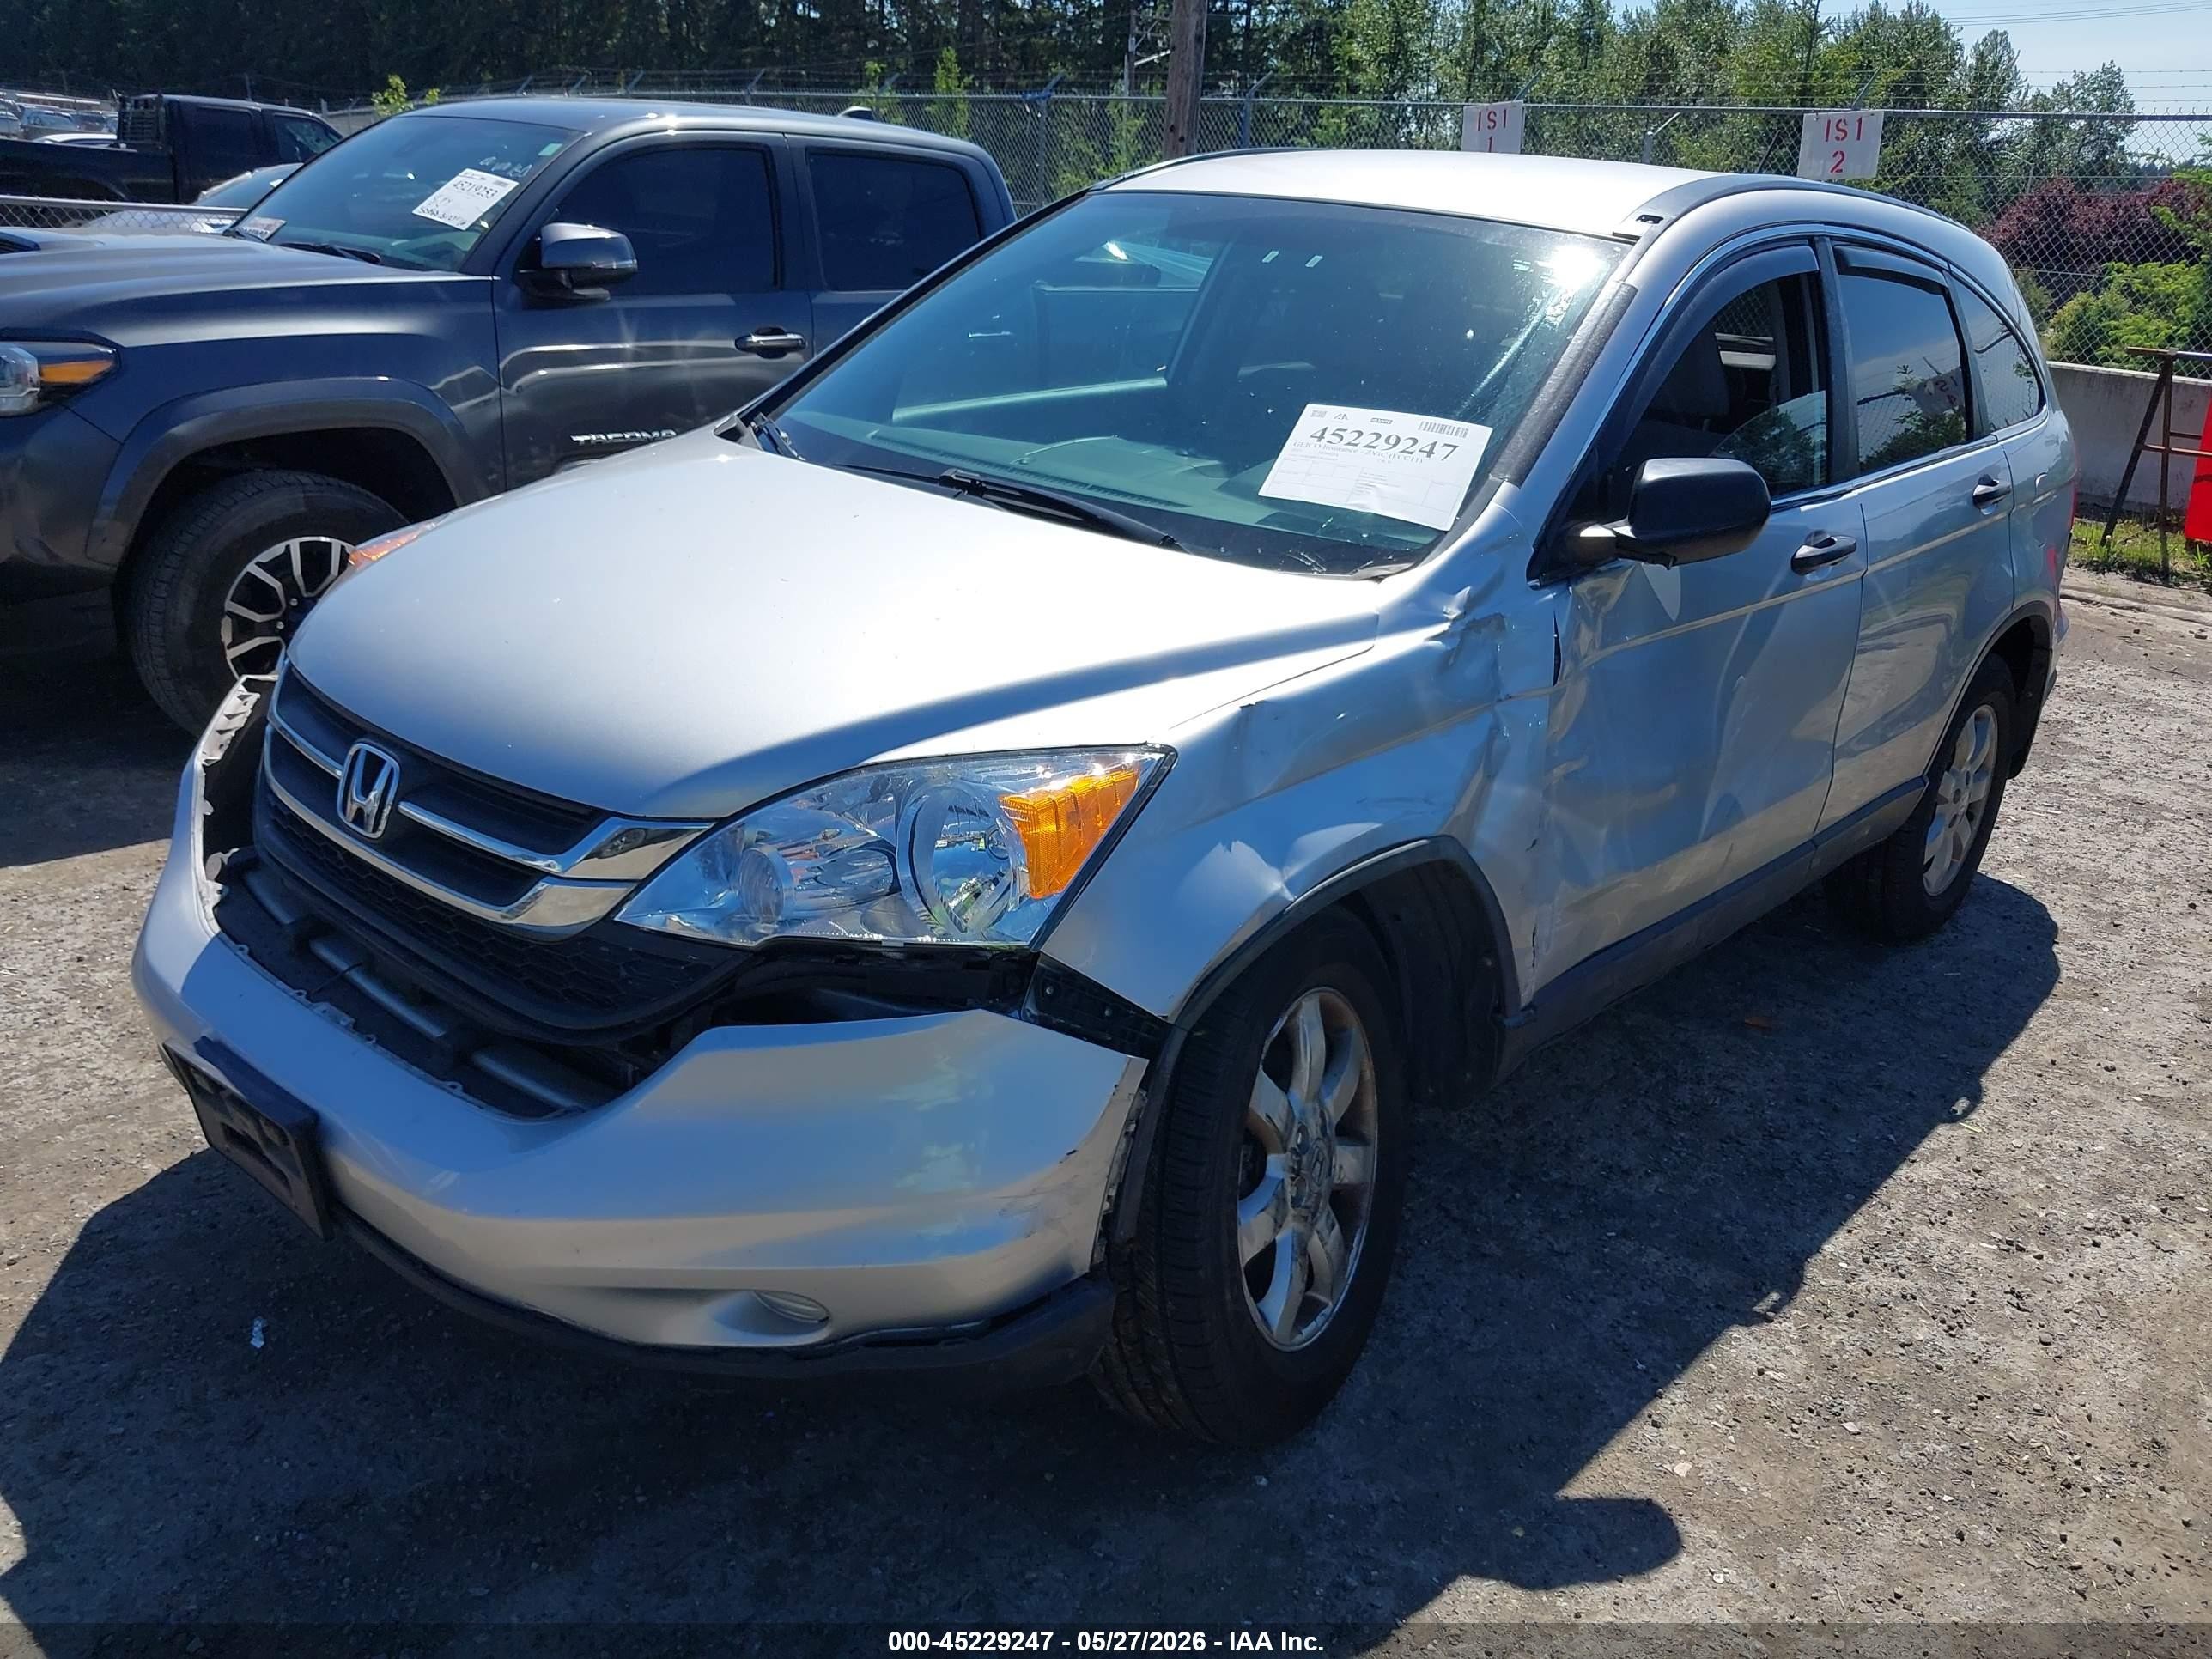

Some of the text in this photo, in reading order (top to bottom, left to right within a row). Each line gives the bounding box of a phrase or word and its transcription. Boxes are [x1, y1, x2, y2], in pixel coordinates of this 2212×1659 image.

[1477, 108, 1508, 131] IS1
[1825, 116, 1863, 143] IS1
[1830, 150, 1845, 173] 2
[1310, 425, 1460, 462] 45229247
